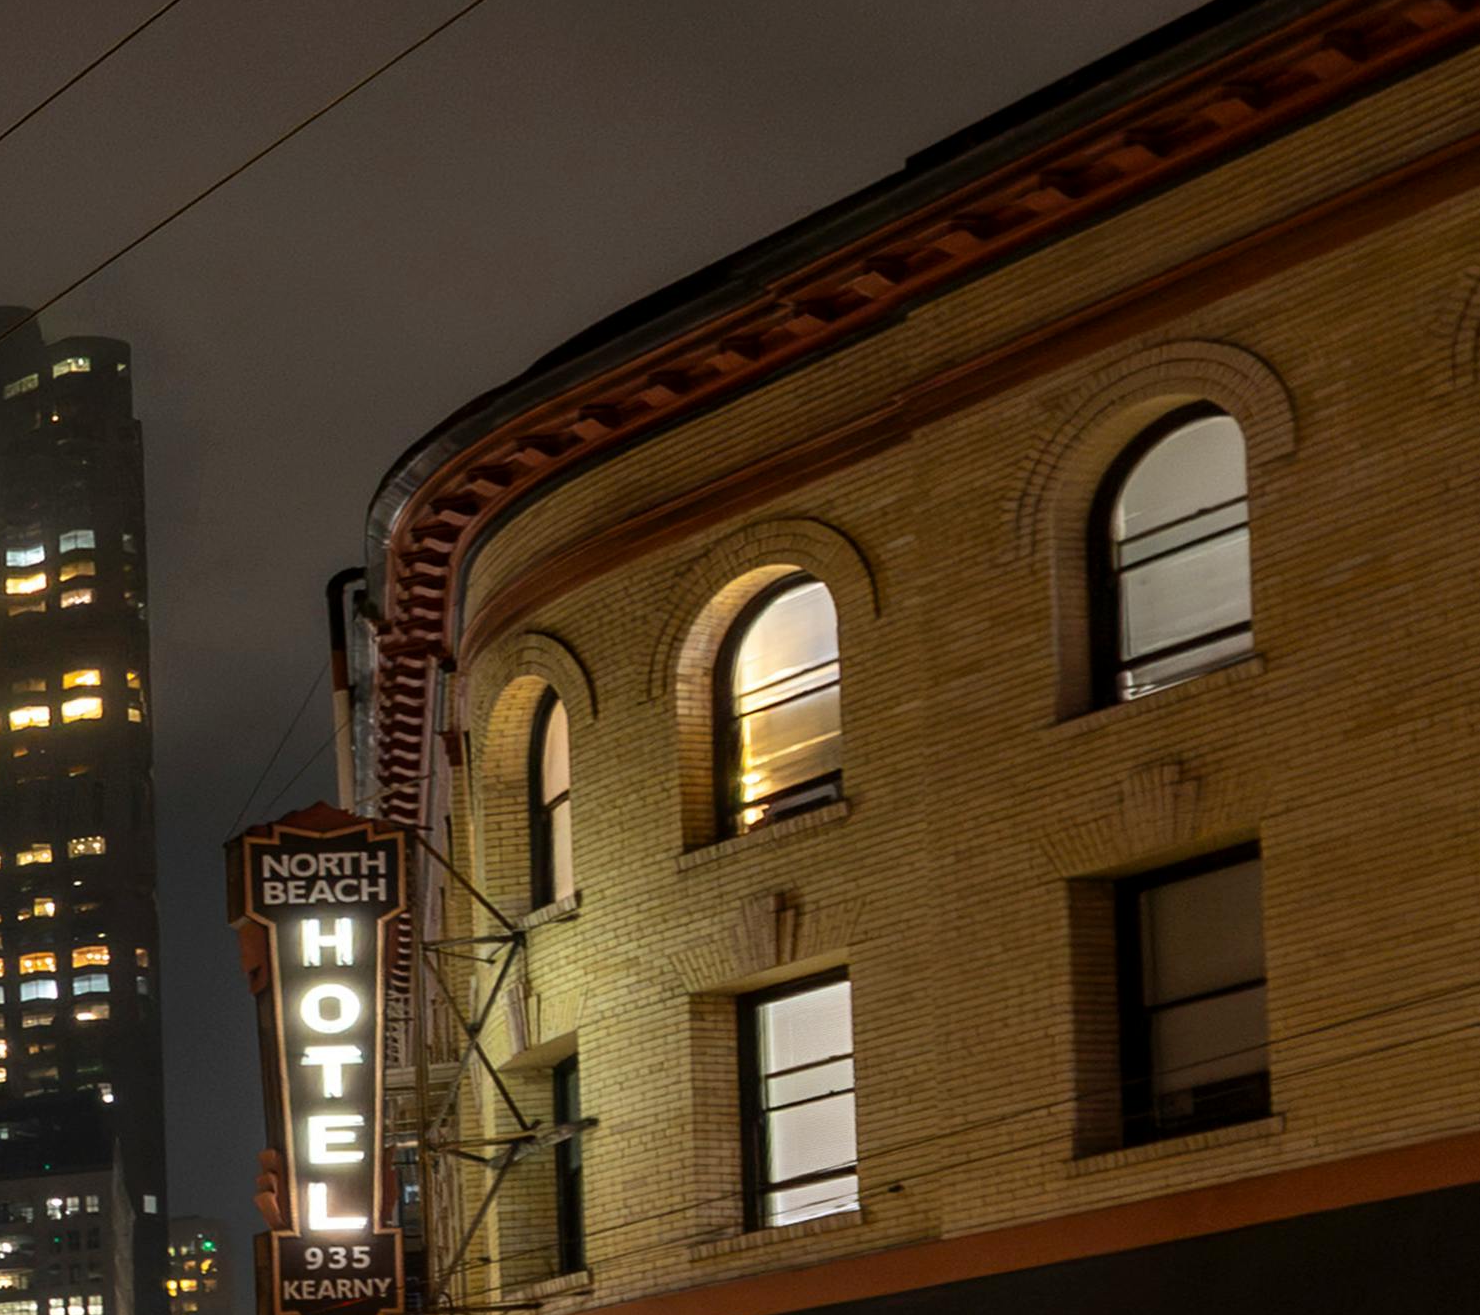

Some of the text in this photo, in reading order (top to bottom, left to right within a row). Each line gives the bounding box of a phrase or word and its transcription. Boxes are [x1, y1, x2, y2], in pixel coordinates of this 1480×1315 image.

[262, 852, 387, 878] NORTH
[263, 879, 387, 905] BEACH
[299, 917, 367, 1231] HOTEL
[304, 1246, 371, 1271] 935
[283, 1277, 392, 1301] KEARNY
